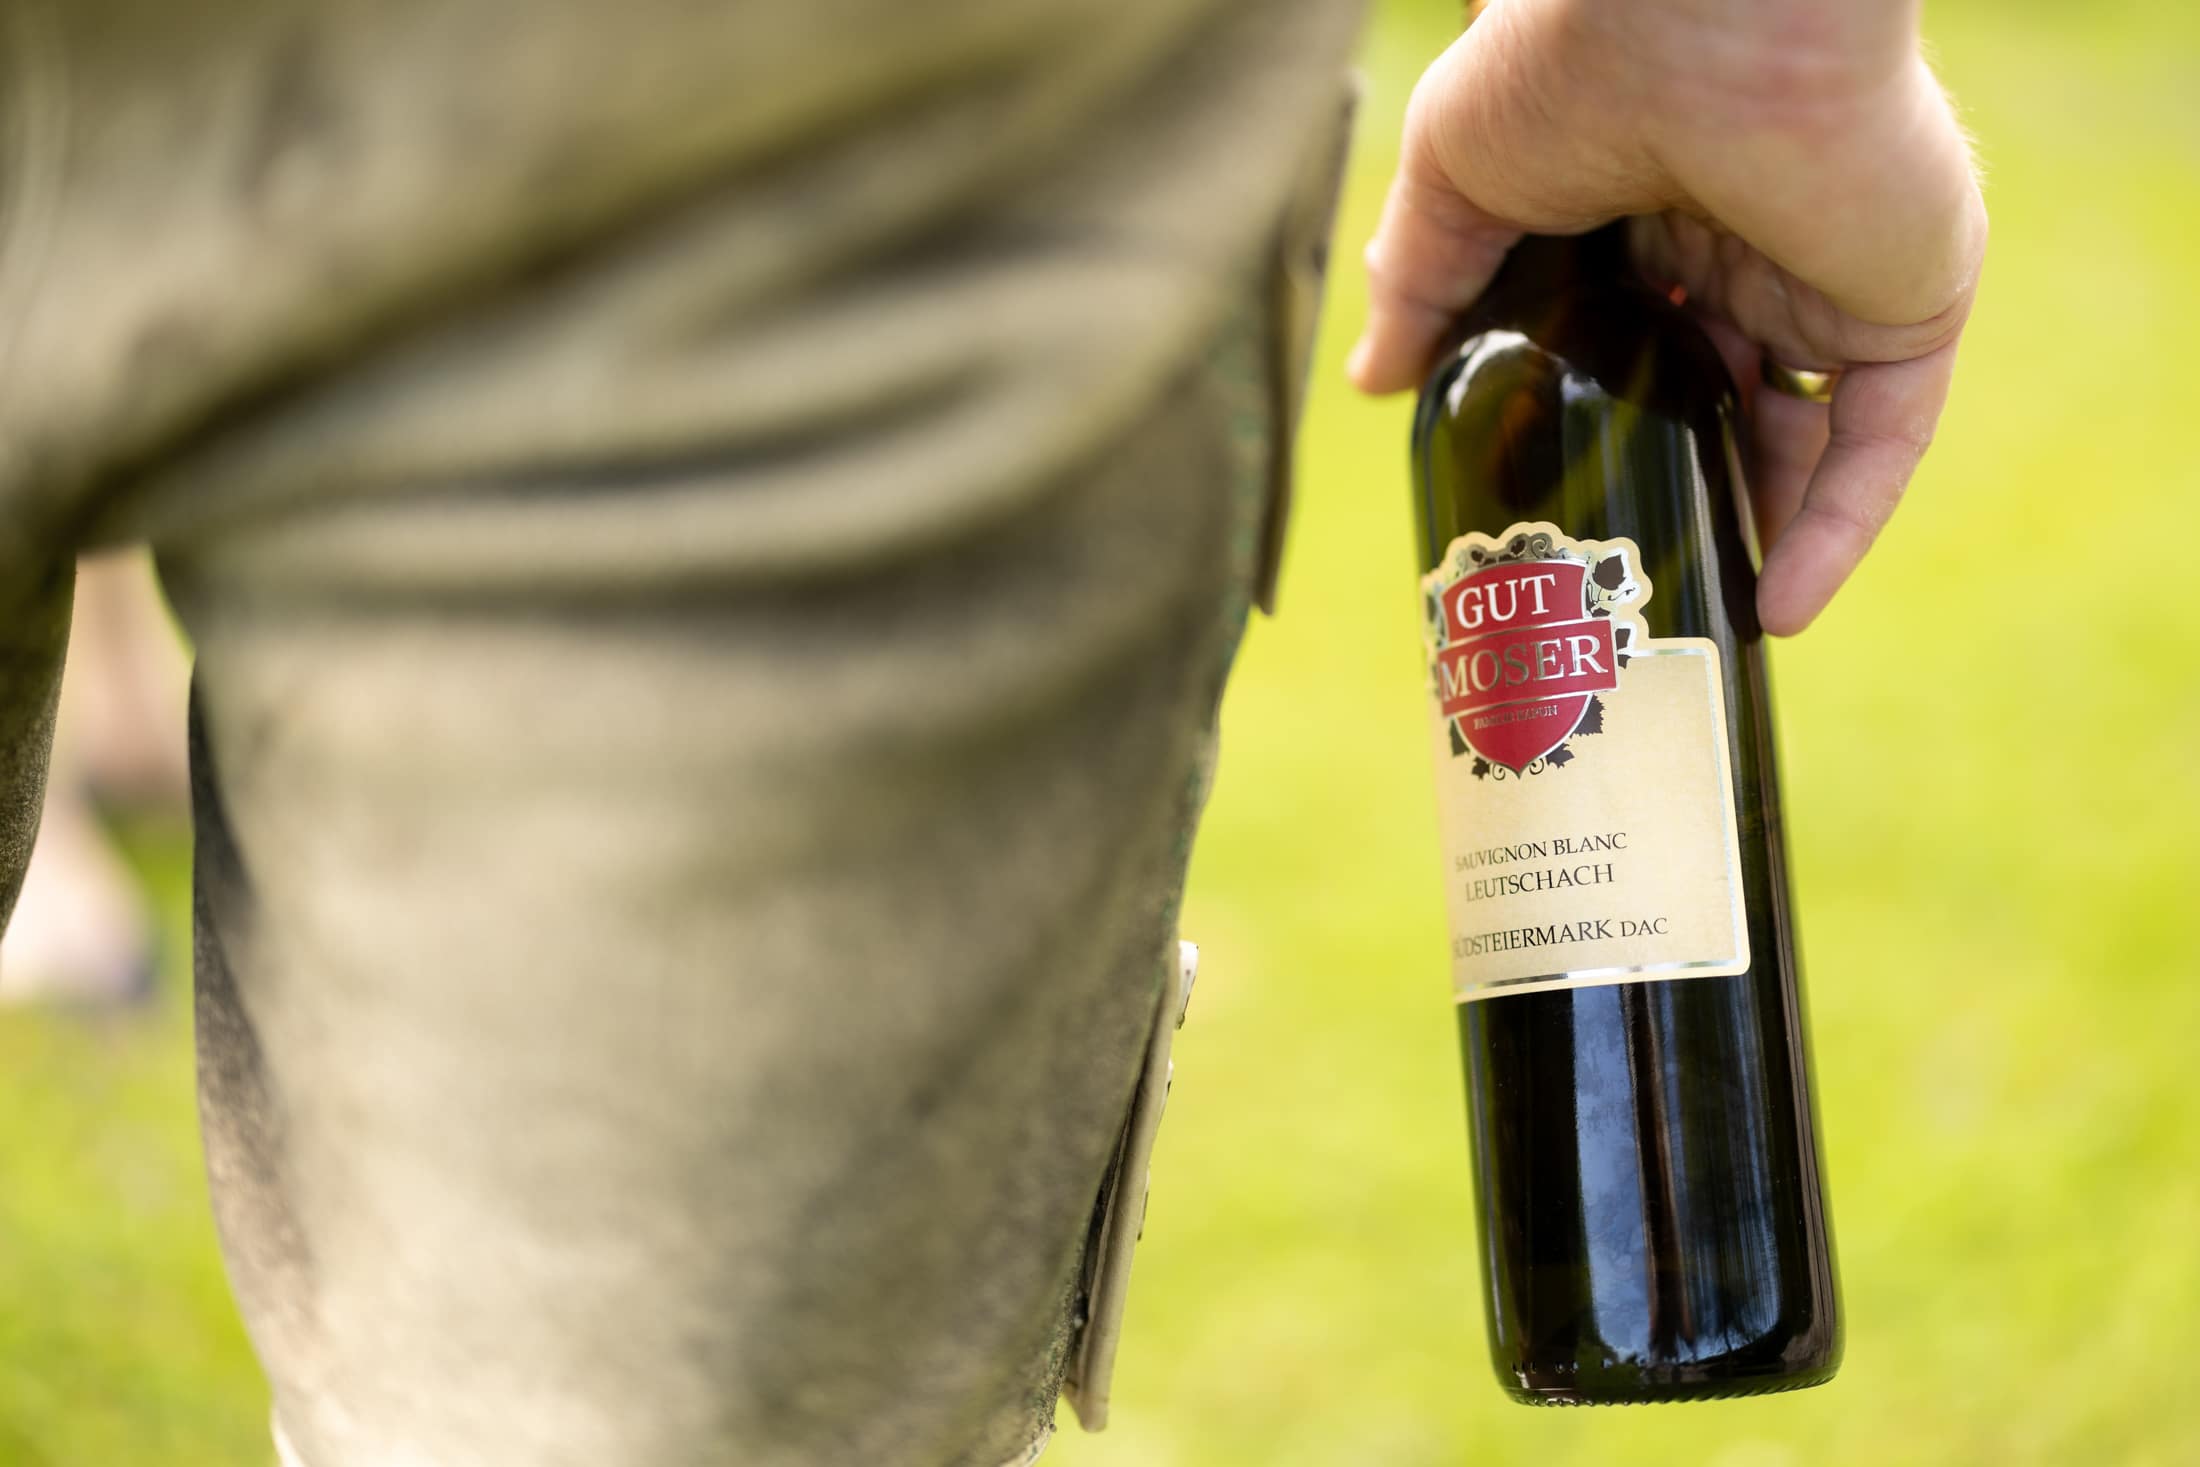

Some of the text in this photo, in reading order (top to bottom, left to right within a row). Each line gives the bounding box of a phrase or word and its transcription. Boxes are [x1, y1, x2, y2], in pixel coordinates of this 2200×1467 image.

[1456, 574, 1556, 629] GUT
[1440, 634, 1608, 702] MOSER
[1455, 832, 1628, 872] SAUVIGNON BLANC
[1466, 863, 1615, 902] LEUTSCHACH
[1620, 917, 1669, 937] DAC
